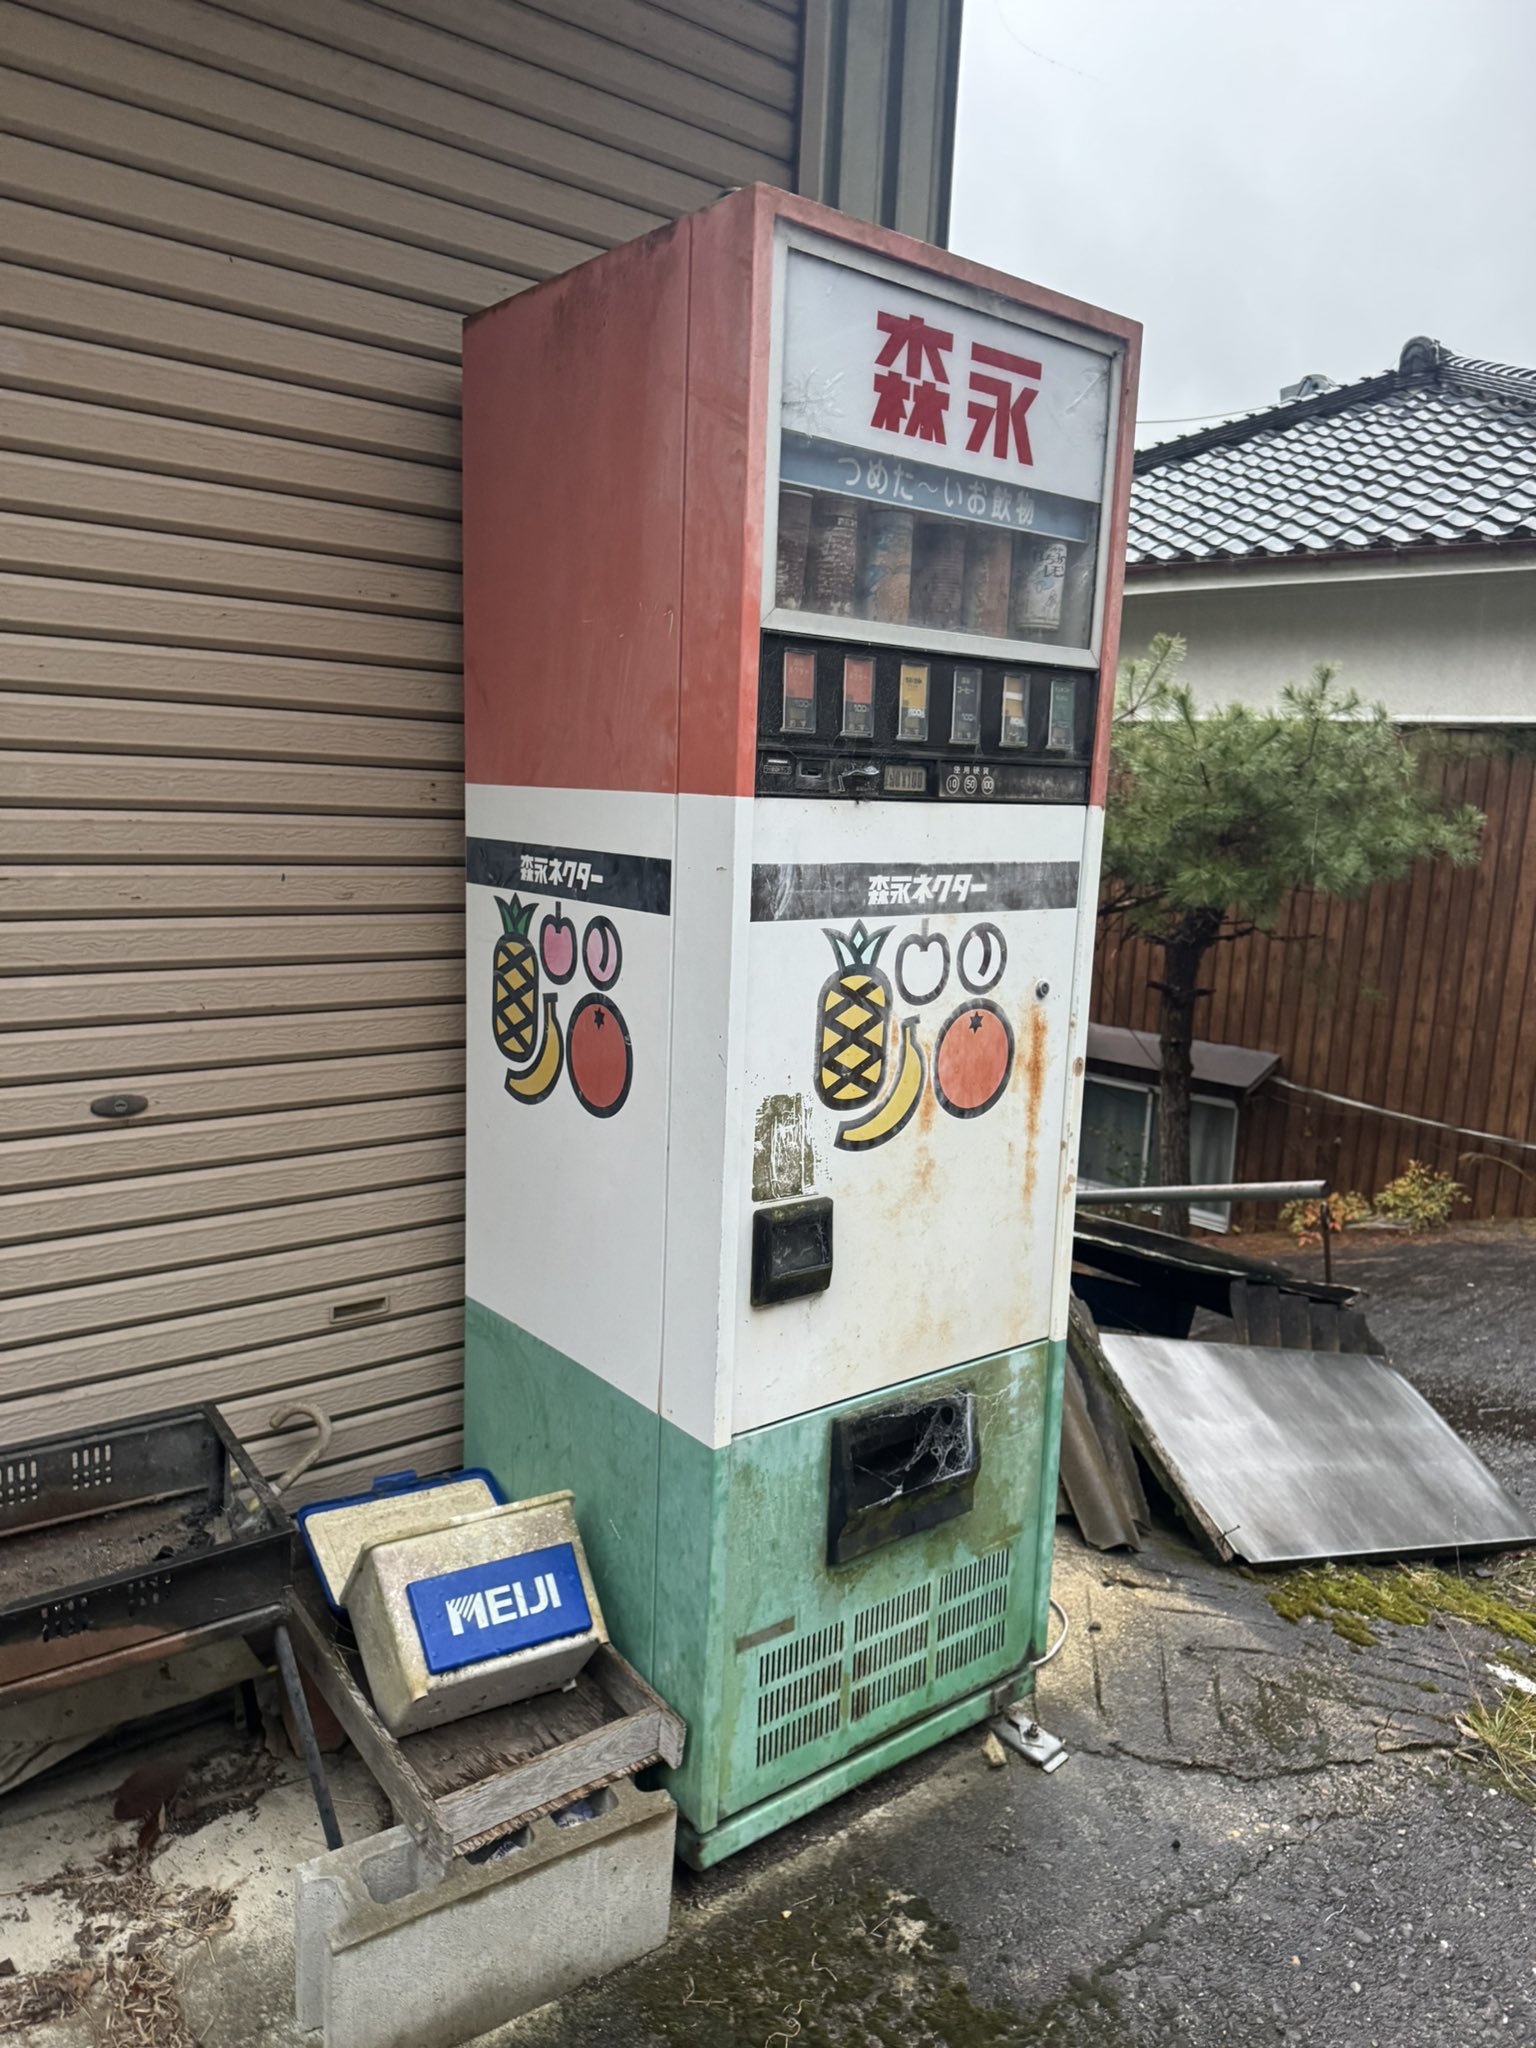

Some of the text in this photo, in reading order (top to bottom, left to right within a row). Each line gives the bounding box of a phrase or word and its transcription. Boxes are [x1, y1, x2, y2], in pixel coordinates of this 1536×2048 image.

[870, 310, 1043, 467] 森永
[949, 777, 957, 789] 10
[966, 777, 975, 790] 50
[520, 854, 604, 890] 森永ネクター
[868, 874, 988, 905] 森永ネクター
[445, 1573, 562, 1637] MEIJI
